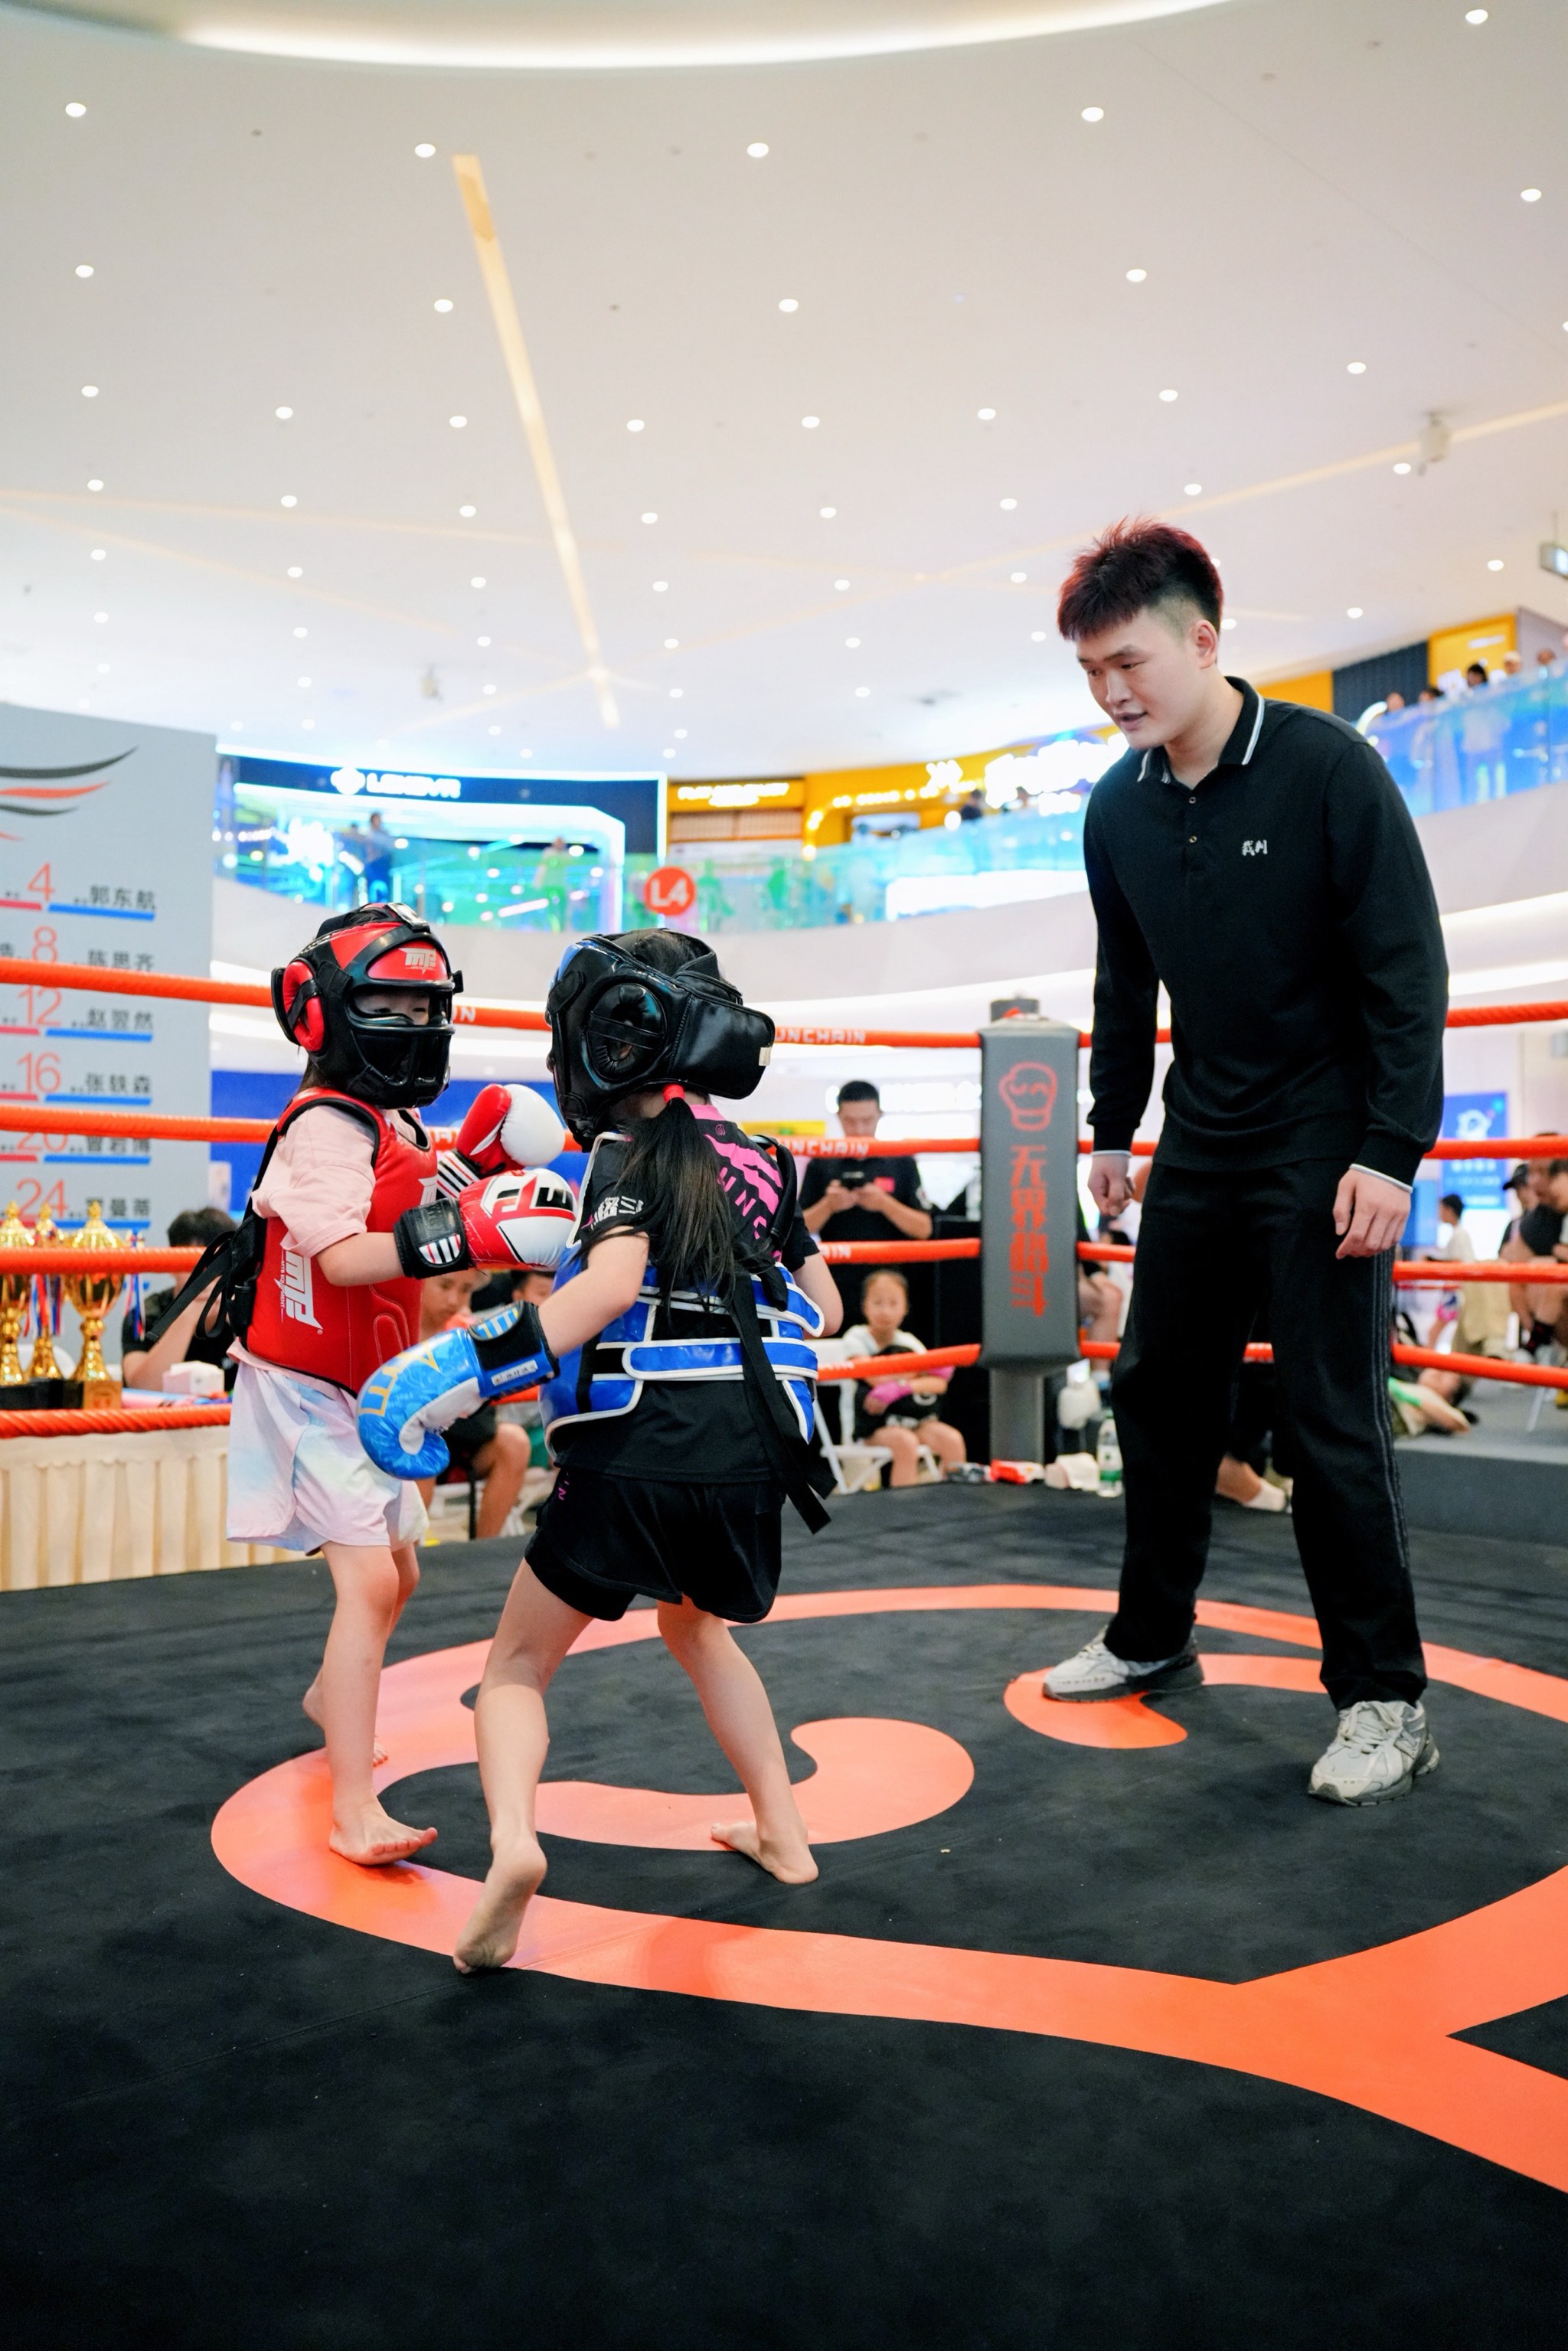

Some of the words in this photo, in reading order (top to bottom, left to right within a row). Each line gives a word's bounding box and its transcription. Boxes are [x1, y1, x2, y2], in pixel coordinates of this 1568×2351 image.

[28, 863, 55, 903] 4
[651, 877, 689, 907] L4
[32, 926, 58, 962] 8
[18, 984, 62, 1027] 12
[17, 1051, 60, 1093] 16
[15, 1177, 67, 1219] 24
